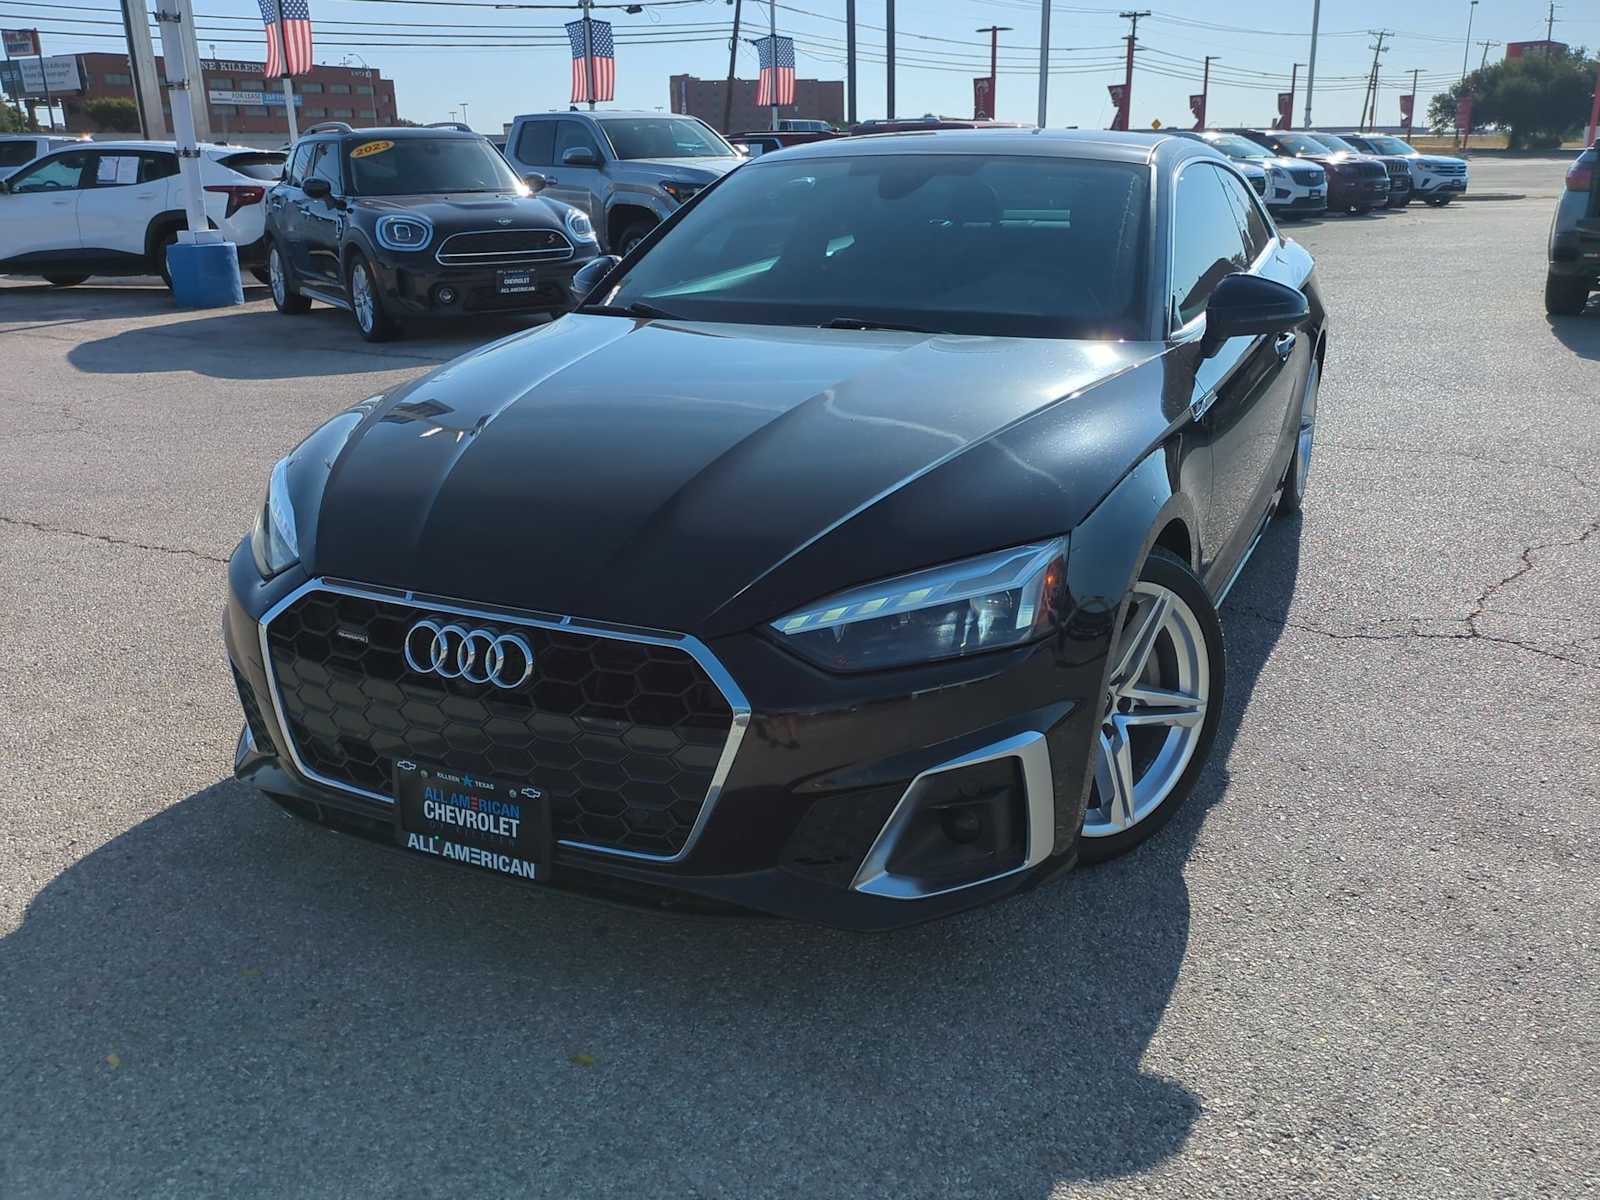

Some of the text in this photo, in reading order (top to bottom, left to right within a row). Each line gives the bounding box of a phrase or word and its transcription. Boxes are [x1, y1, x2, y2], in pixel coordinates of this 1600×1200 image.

[219, 63, 265, 73] KILLEEN
[355, 141, 390, 156] 2023
[437, 772, 495, 790] KILLEEN TEXAS
[424, 787, 519, 818] ALL AMERICAN
[424, 800, 520, 838] CHEVROLET
[407, 833, 535, 879] ALL AMERICAN
